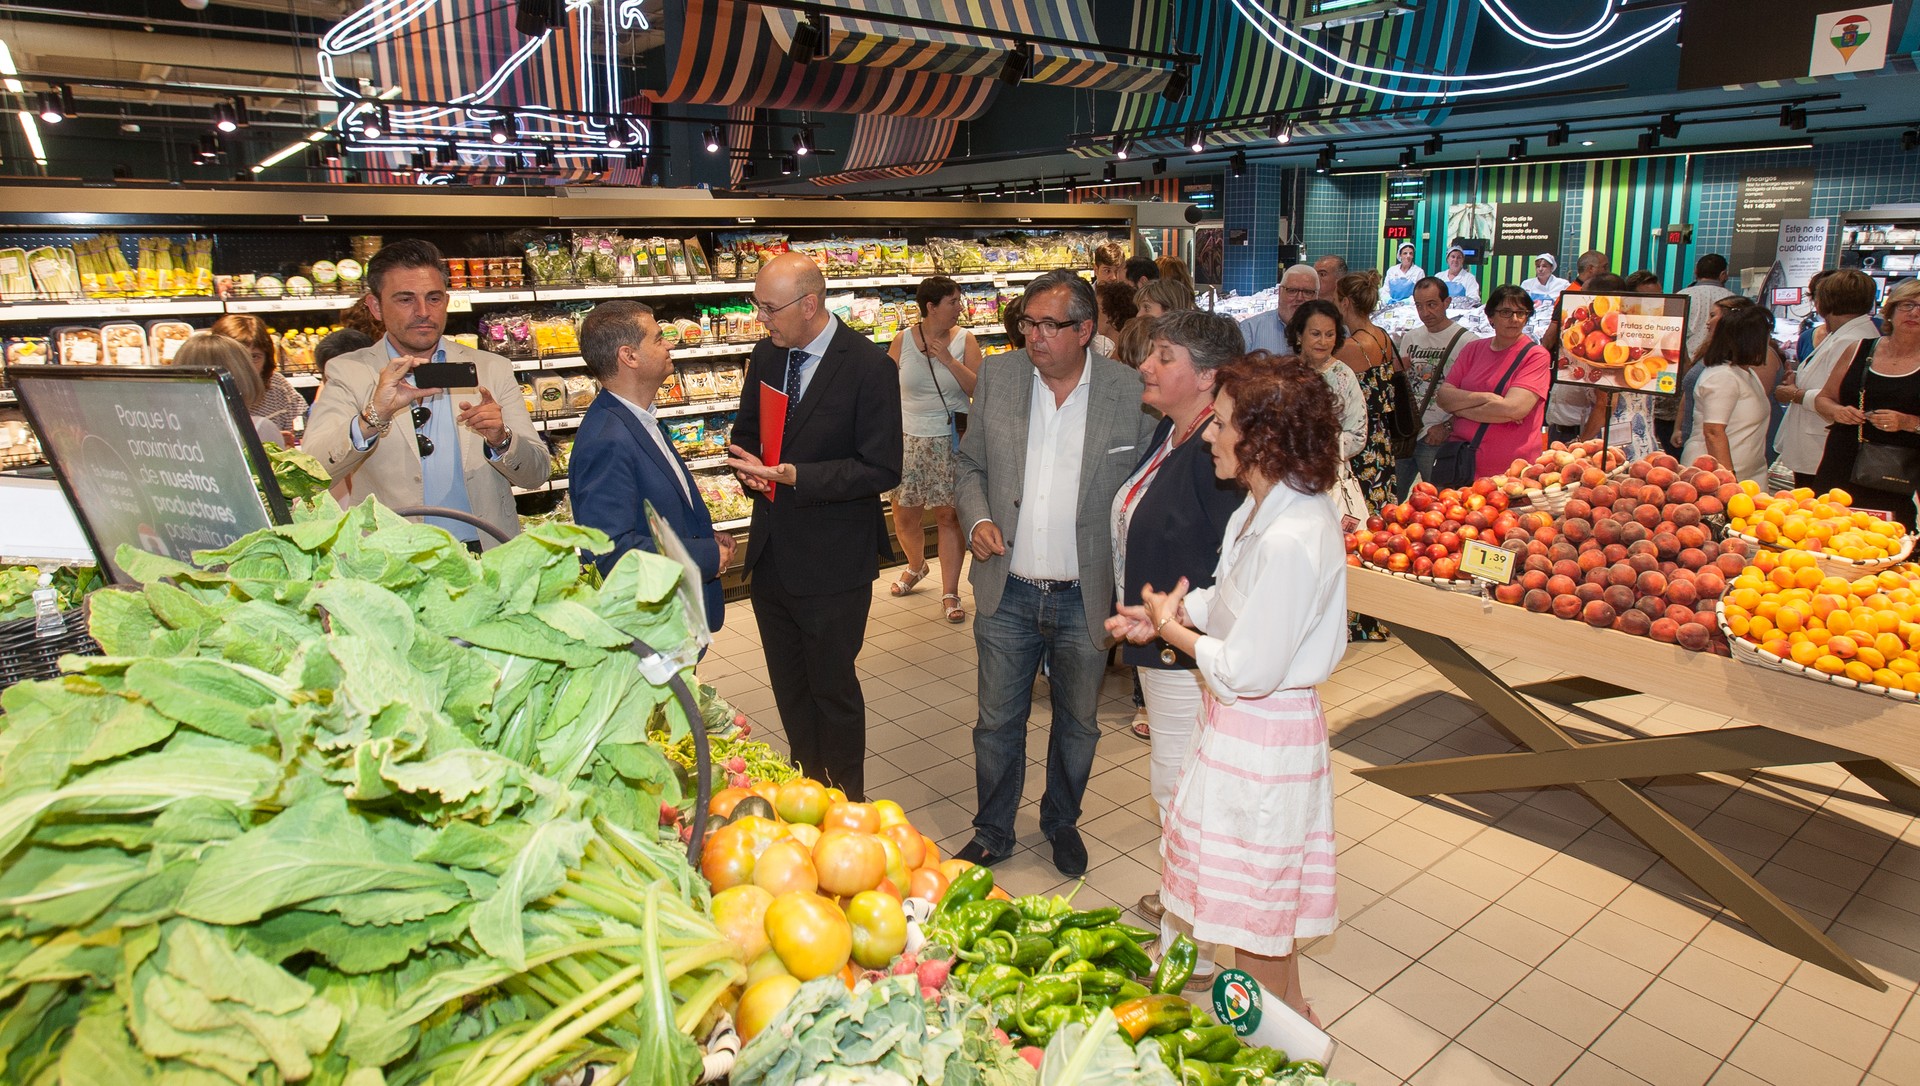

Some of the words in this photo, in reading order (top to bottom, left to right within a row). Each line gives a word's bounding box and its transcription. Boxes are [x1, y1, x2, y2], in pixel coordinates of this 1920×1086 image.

[1388, 228, 1406, 237] P171
[1785, 225, 1801, 233] Este
[1779, 243, 1822, 253] cualquiera
[1620, 322, 1643, 330] Frutas
[1656, 324, 1680, 332] hueso
[115, 404, 164, 433] Porque
[164, 408, 181, 430] la
[127, 437, 204, 463] proximidad
[140, 464, 159, 485] de
[159, 469, 220, 493] nuestros
[152, 495, 236, 523] productores
[165, 522, 222, 547] posibilita
[1223, 973, 1232, 983] por
[1234, 974, 1245, 982] ser
[1245, 980, 1253, 990] de
